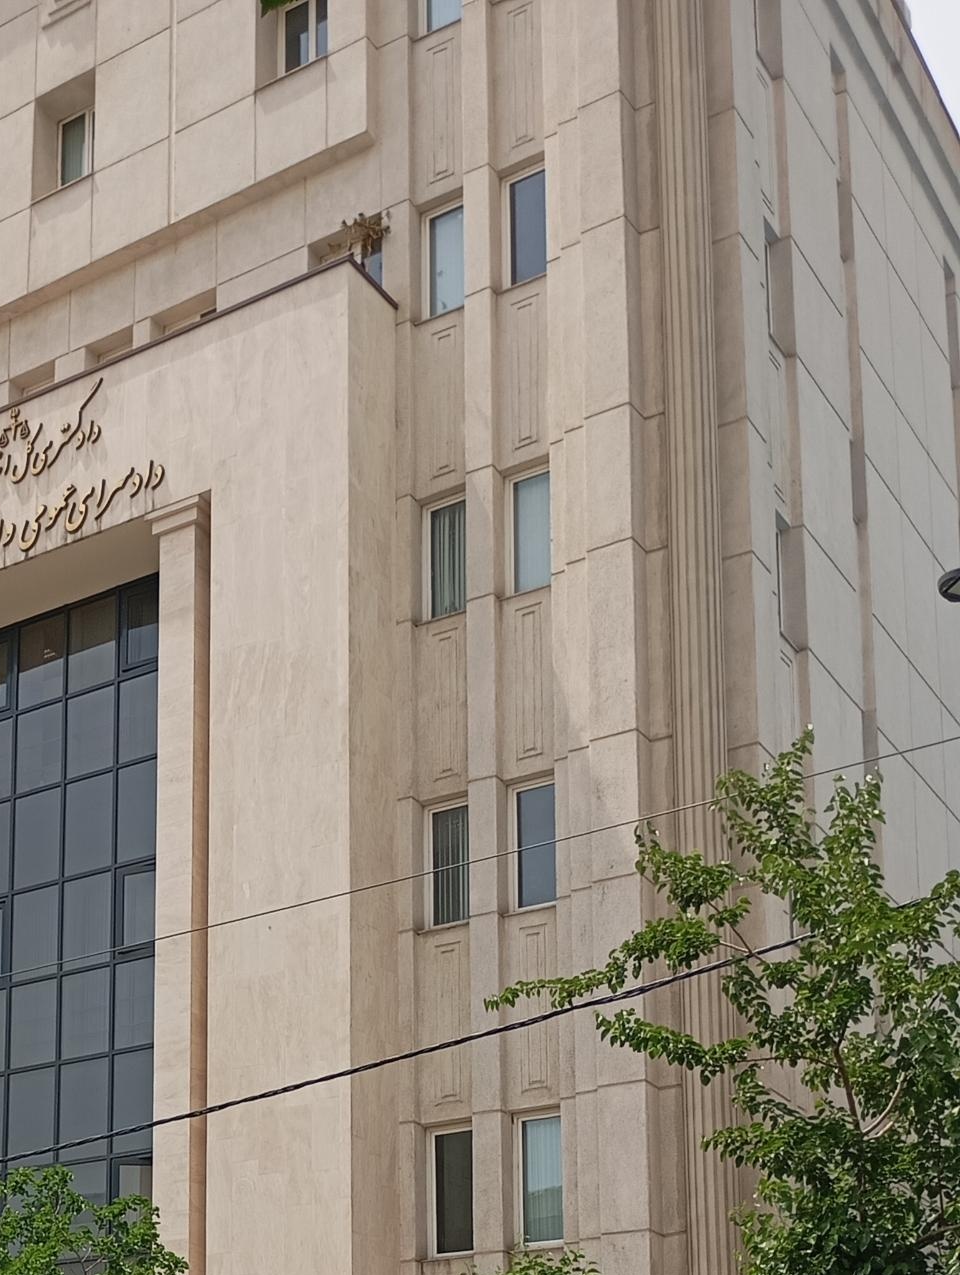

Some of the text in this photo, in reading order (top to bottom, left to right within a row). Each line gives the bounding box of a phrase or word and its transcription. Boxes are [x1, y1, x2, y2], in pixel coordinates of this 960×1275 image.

[12, 422, 43, 484] کل
[31, 377, 103, 477] دادگستری
[19, 484, 77, 552] عمومی
[65, 460, 165, 533] دادسرای
